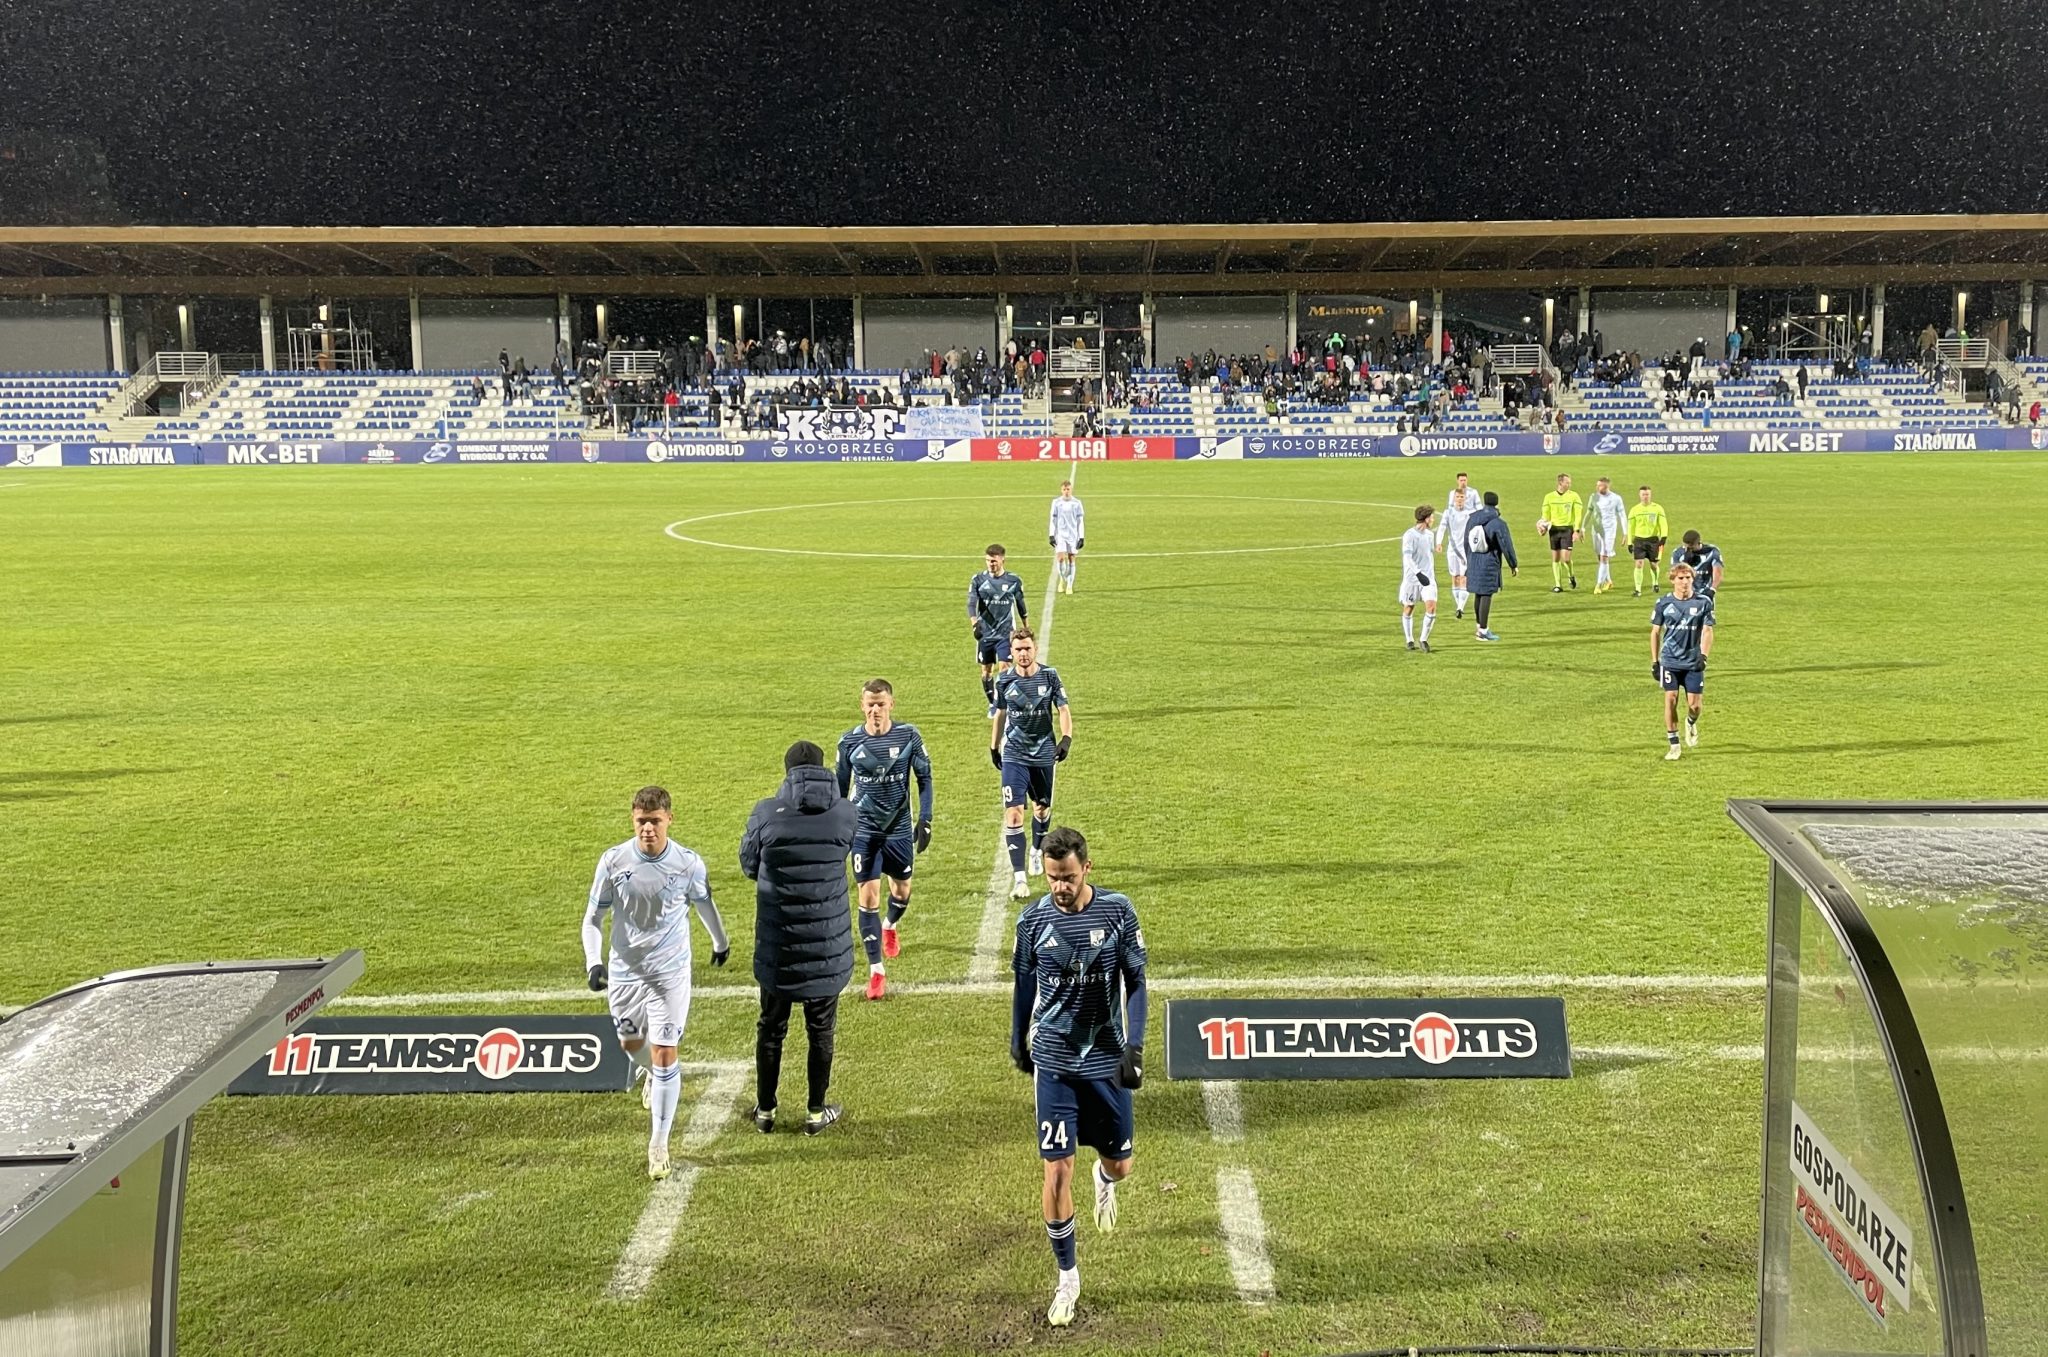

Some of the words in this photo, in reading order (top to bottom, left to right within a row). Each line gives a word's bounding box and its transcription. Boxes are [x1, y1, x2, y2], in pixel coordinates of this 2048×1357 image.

[667, 442, 744, 457] HYDROBUD
[794, 443, 895, 454] KOŁOBRZEG
[1038, 440, 1053, 459] 2
[1059, 440, 1107, 459] LIGA
[1272, 438, 1371, 450] KOŁOBRZEG
[1421, 437, 1497, 450] HYDROBUD
[1630, 444, 1675, 452] HYDROBUD
[1749, 432, 1843, 452] MK-BET
[227, 444, 322, 464] MK-BET
[1664, 671, 1672, 684] 5
[854, 853, 863, 873] 8
[285, 985, 325, 1027] PESMENPOL
[1041, 1120, 1068, 1150] 24
[1793, 1123, 1908, 1289] GOSPODARZE
[1796, 1184, 1886, 1318] PESMENPOL
